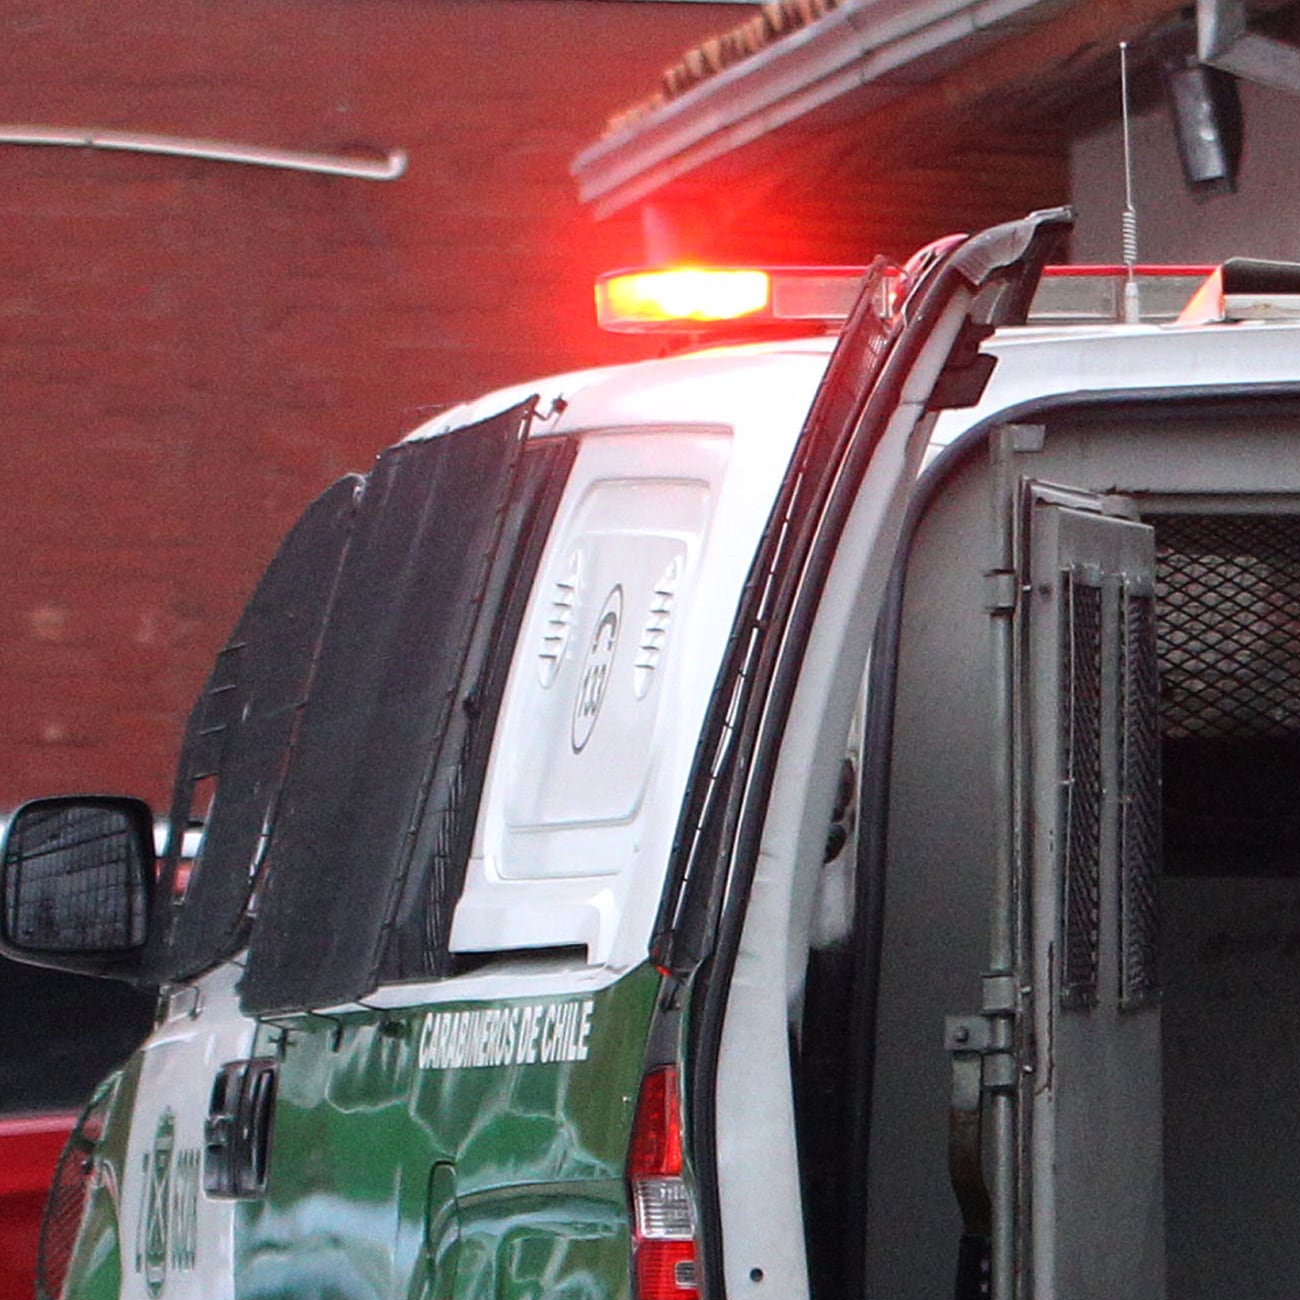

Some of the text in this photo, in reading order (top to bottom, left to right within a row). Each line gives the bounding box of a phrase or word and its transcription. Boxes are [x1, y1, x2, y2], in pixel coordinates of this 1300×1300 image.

[418, 1000, 595, 1070] CARABINEROS DE CHILE
